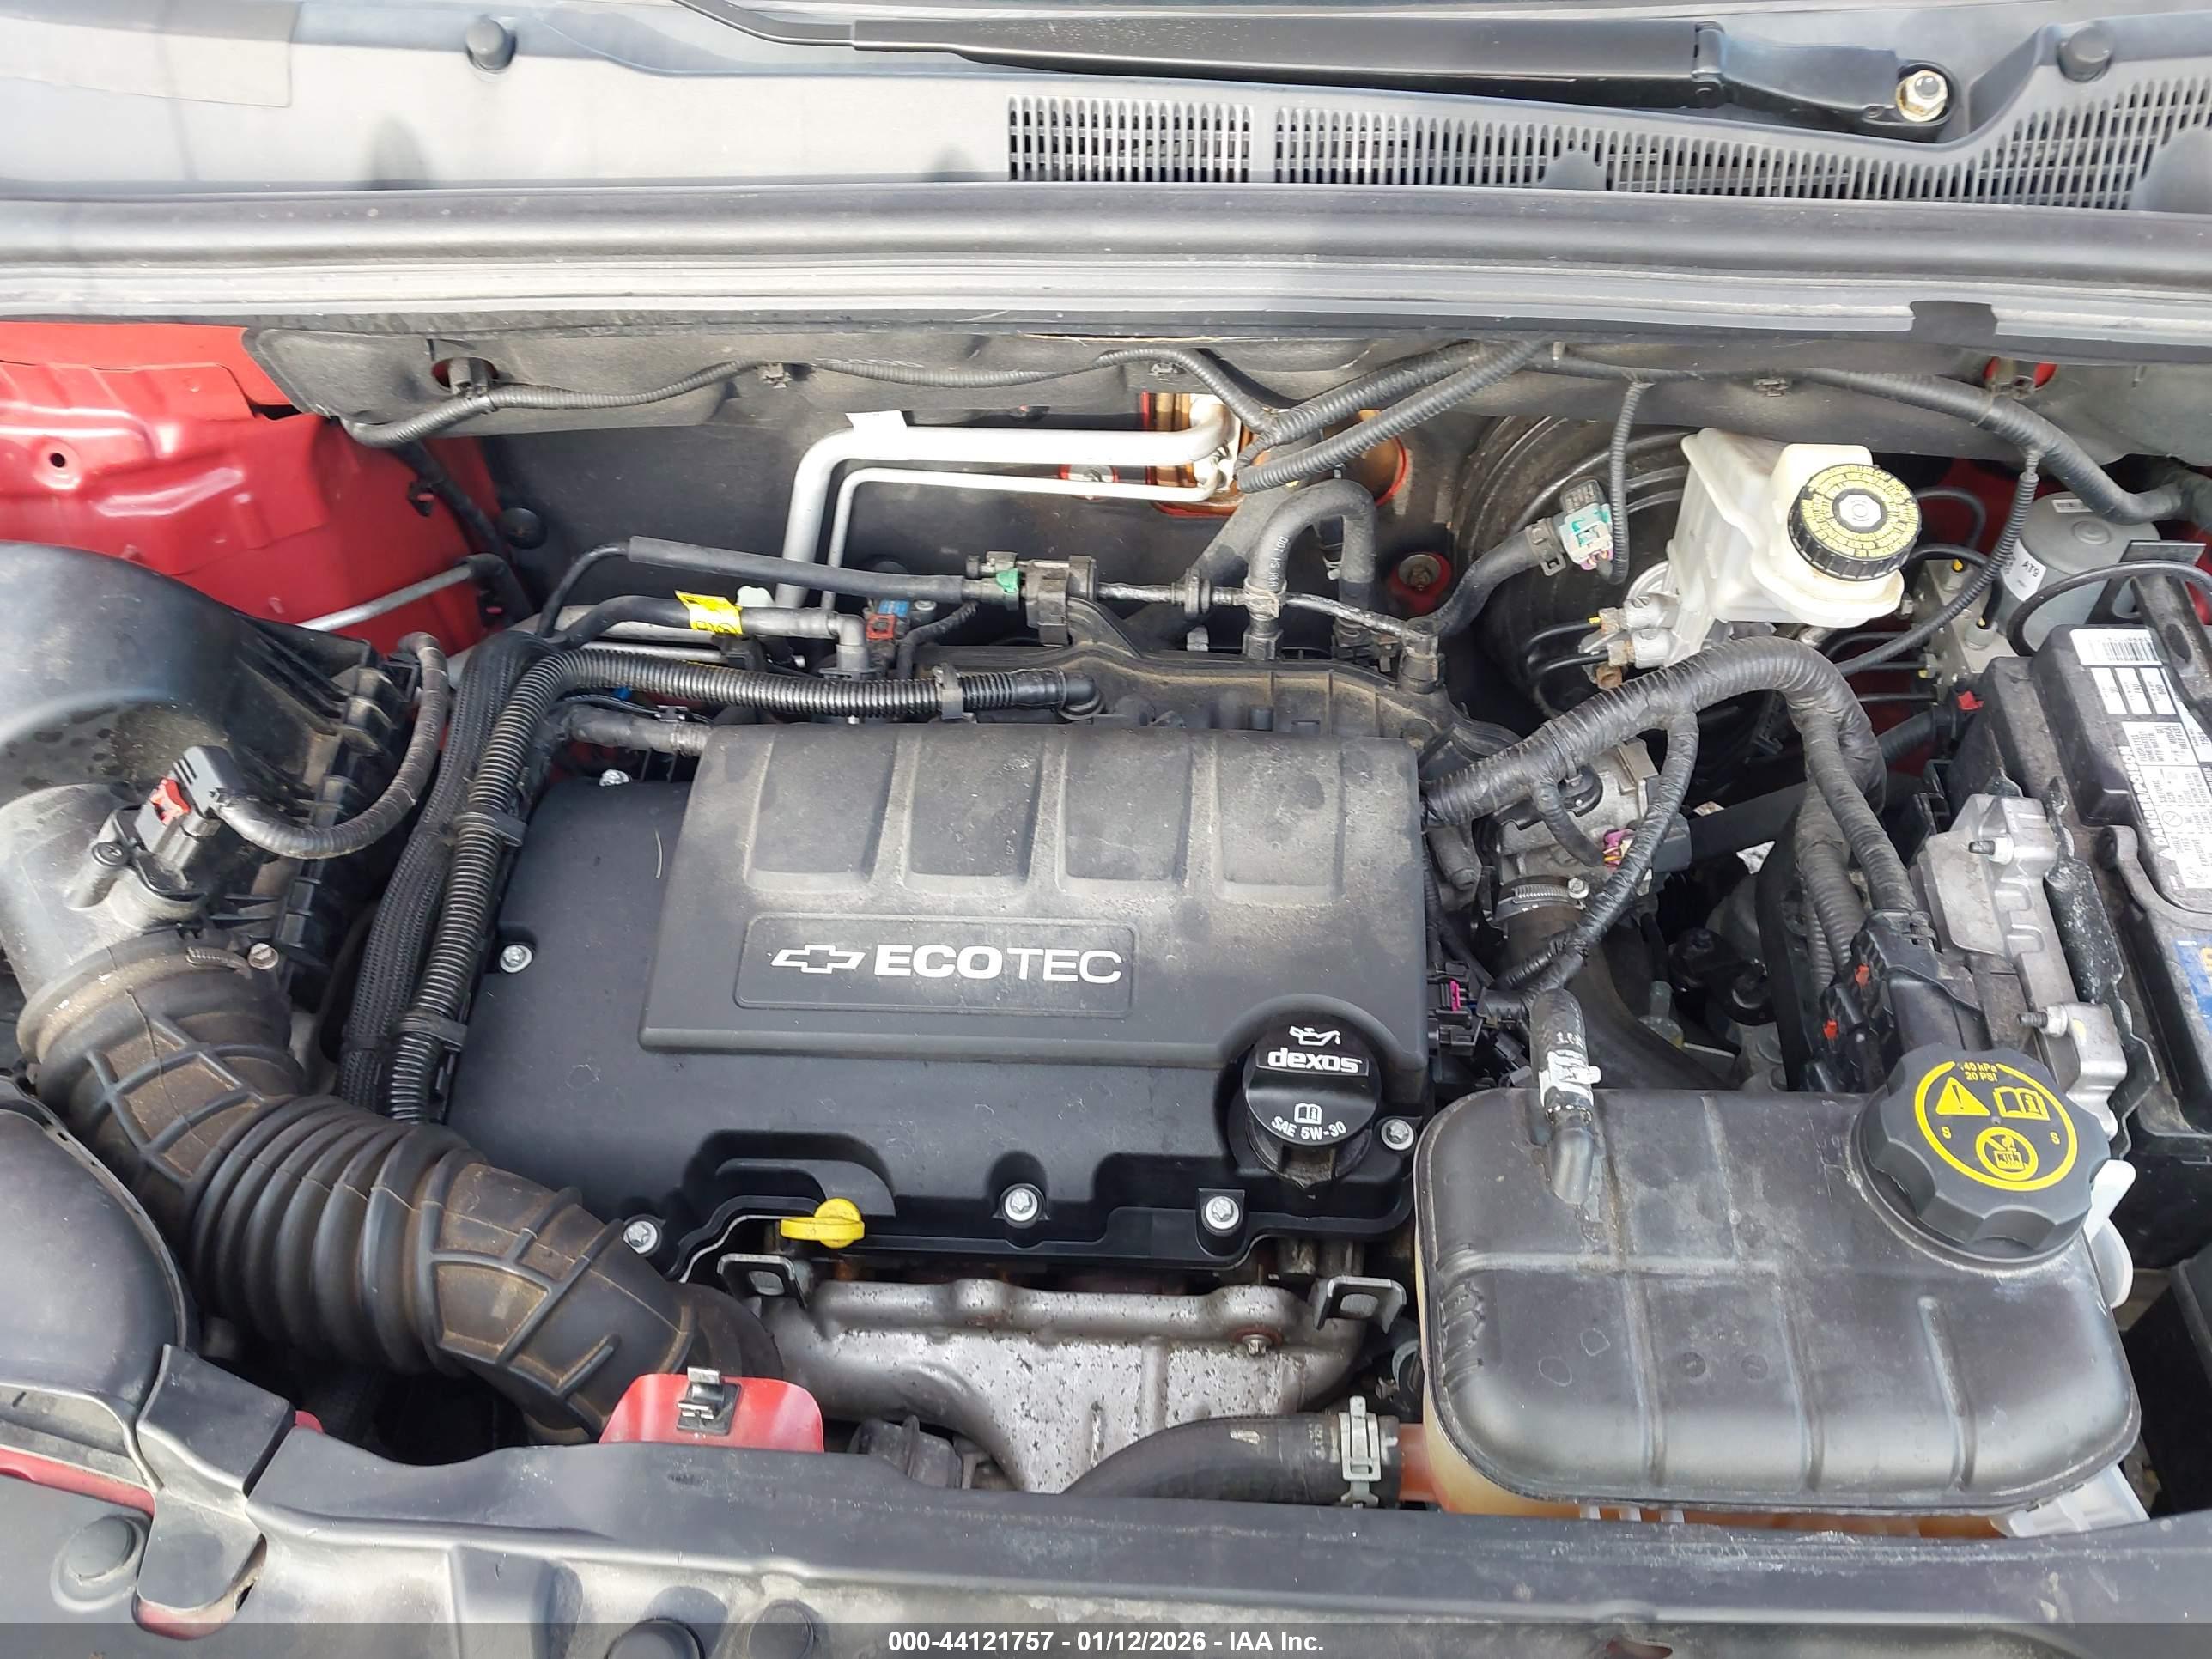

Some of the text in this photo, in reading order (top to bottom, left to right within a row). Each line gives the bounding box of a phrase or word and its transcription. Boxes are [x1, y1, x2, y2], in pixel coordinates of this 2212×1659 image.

[2117, 745, 2168, 846] DANGER/POISON
[873, 944, 1122, 983] ECOTEC
[1267, 1048, 1363, 1073] dexos
[1965, 1072, 1998, 1081] 20 PSI
[1272, 1116, 1346, 1140] SAE 5W-30
